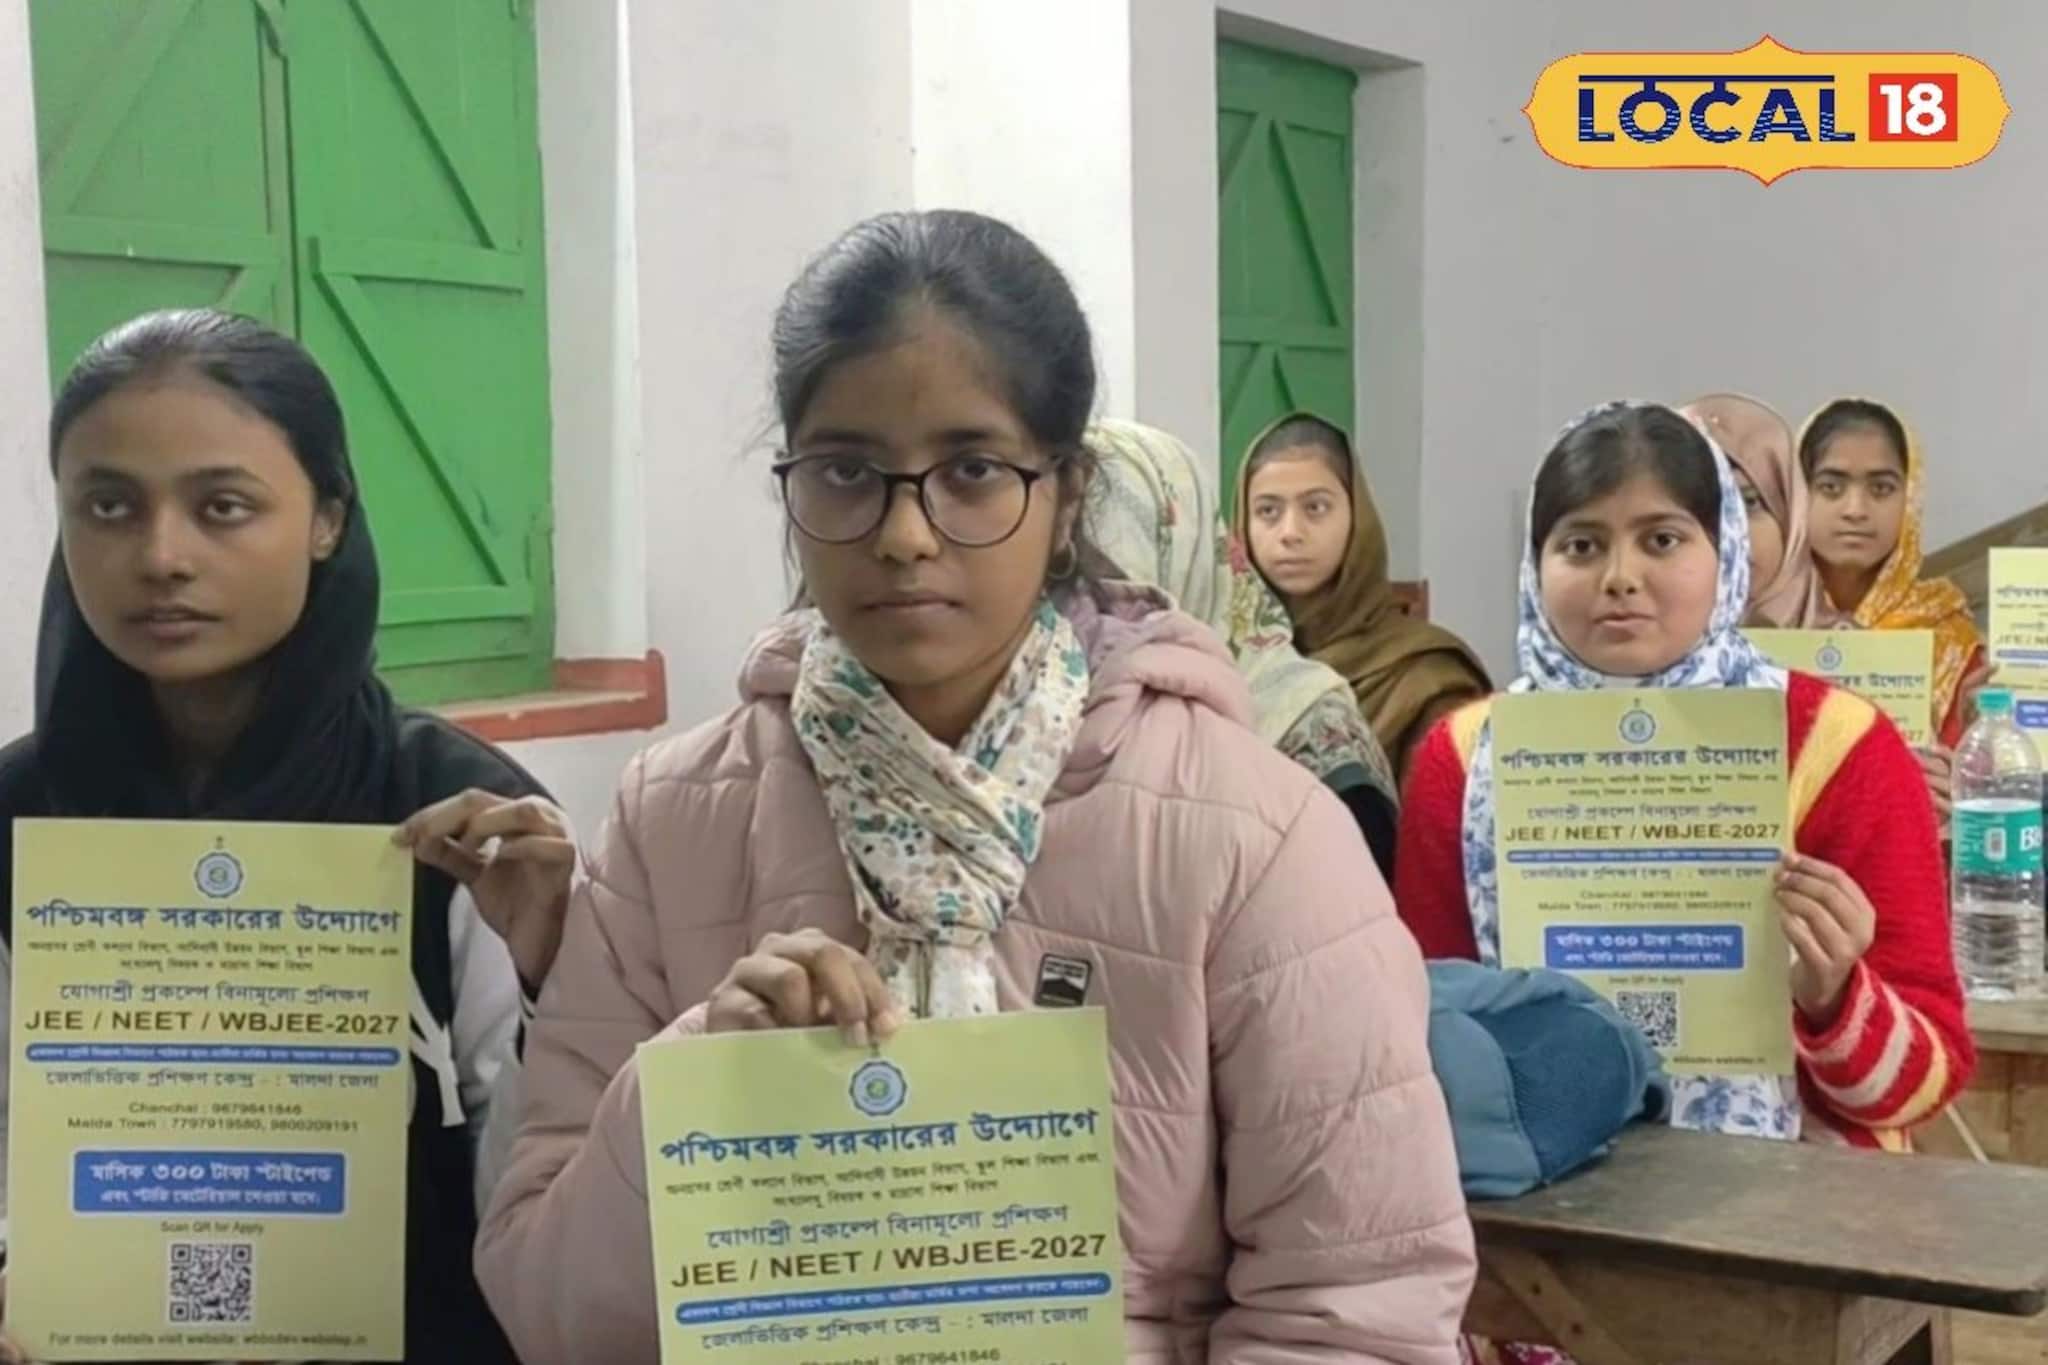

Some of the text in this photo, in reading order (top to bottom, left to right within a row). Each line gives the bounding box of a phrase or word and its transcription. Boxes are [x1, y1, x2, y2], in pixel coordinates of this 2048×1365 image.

[1500, 743, 1779, 769] পশ্চিমবঙ্গ সরকারের উদ্যোগে
[1505, 826, 1545, 842] JEE
[1565, 825, 1624, 841] NEET
[1642, 823, 1781, 840] WBJEE-2027
[26, 897, 402, 933] পশ্চিমবঙ্গ সরকারের উদ্যোগে
[25, 1010, 84, 1031] JEE
[111, 1011, 193, 1031] NEET
[218, 1012, 400, 1035] WBJEE-2027
[128, 1101, 199, 1114] Chanchal
[119, 1117, 157, 1129] Town
[660, 1107, 1100, 1166] পশ্চিমবঙ্গ সরকারের উদ্যোগে
[88, 1160, 146, 1181] মাসিক
[151, 1162, 206, 1181] ৩০০
[210, 1161, 250, 1182] টাকা
[991, 1203, 1069, 1229] প্রশিক্ষণ
[671, 1260, 739, 1289] JEE
[768, 1251, 864, 1280] NEET
[893, 1233, 1107, 1270] WBJEE-2027
[1041, 1307, 1090, 1325] জেলা
